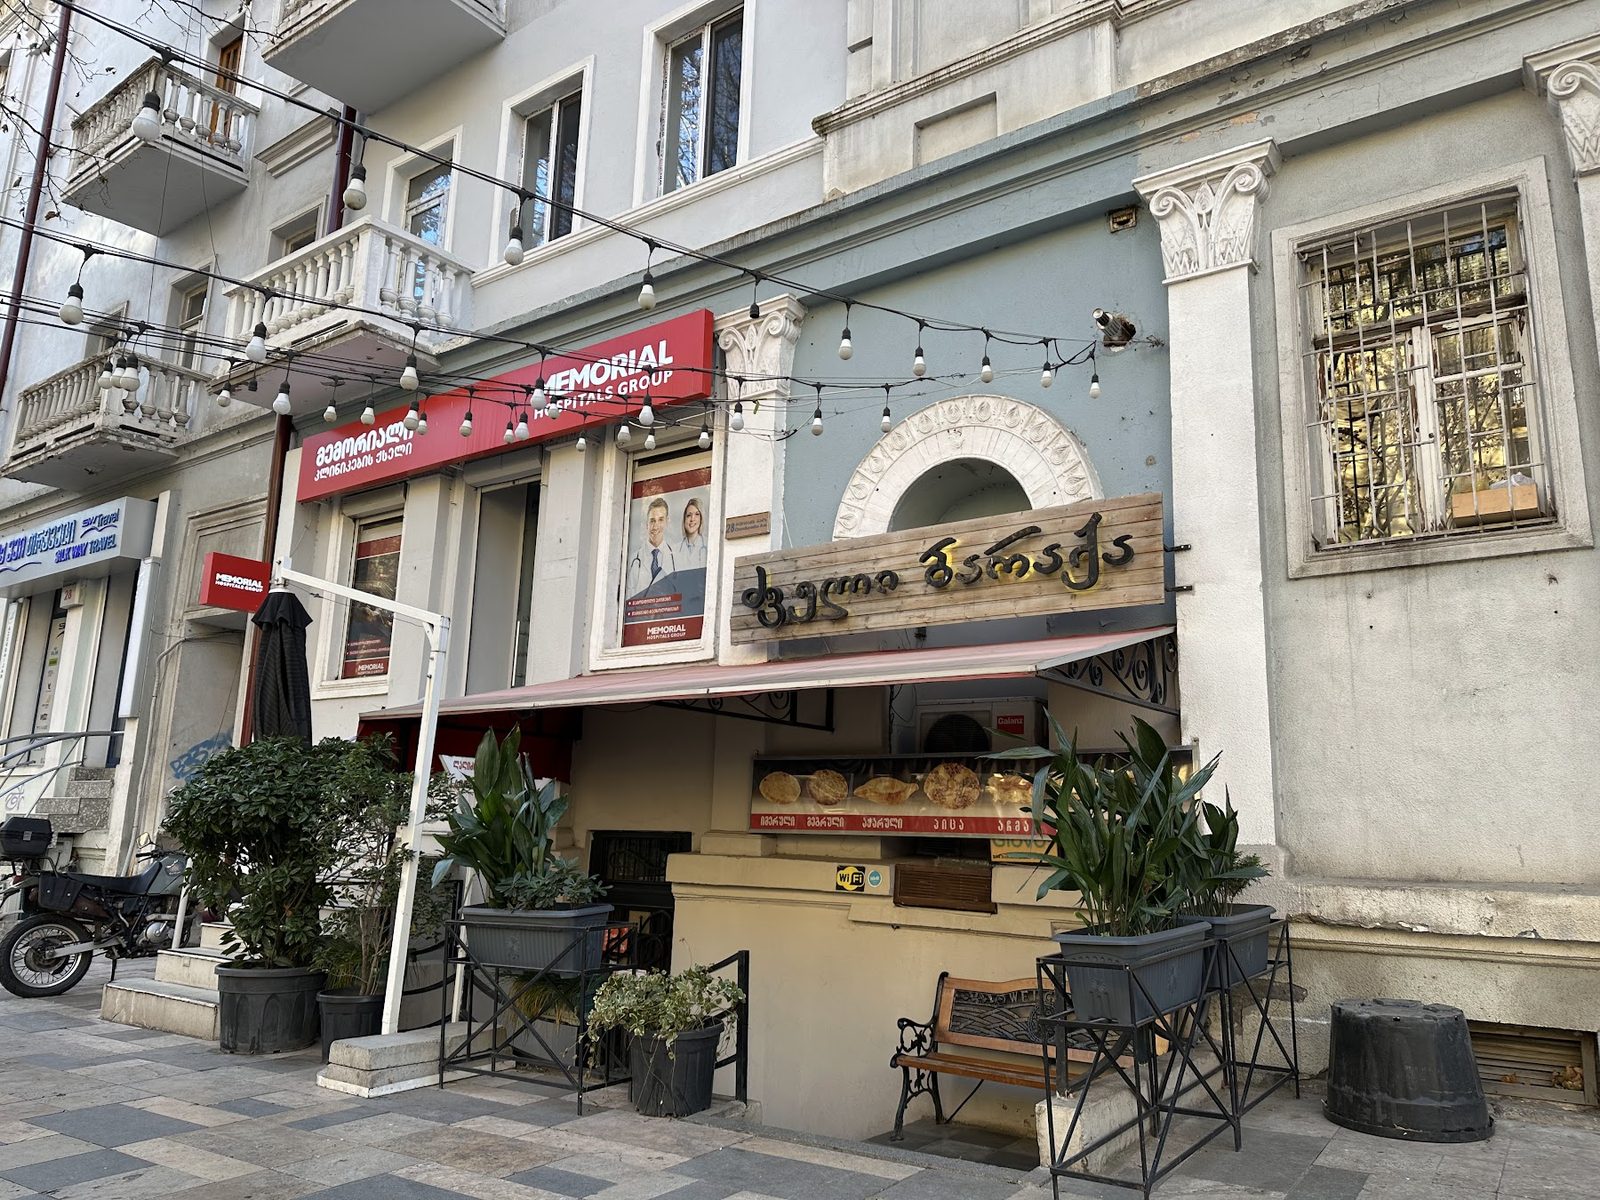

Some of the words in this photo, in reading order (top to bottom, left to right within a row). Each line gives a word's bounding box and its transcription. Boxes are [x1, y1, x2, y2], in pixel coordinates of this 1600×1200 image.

[542, 340, 674, 395] MEMORIAL
[617, 370, 673, 395] GROUP
[314, 453, 374, 482] კლინიკების
[375, 442, 413, 464] ქსელი
[55, 546, 72, 564] SILK
[71, 542, 89, 560] WAY
[89, 534, 117, 554] TRAVEL
[215, 573, 263, 588] MEMORIAL
[741, 566, 899, 629] ძველი
[919, 512, 1135, 591] ბარაქა
[647, 624, 686, 635] MEMORIAL
[358, 662, 384, 671] MEMORIAL
[760, 816, 796, 827] იმერული
[807, 816, 844, 828] მეგრული
[862, 817, 903, 829] აჭარული
[934, 819, 965, 831] პიცა
[997, 820, 1029, 832] აჩმა
